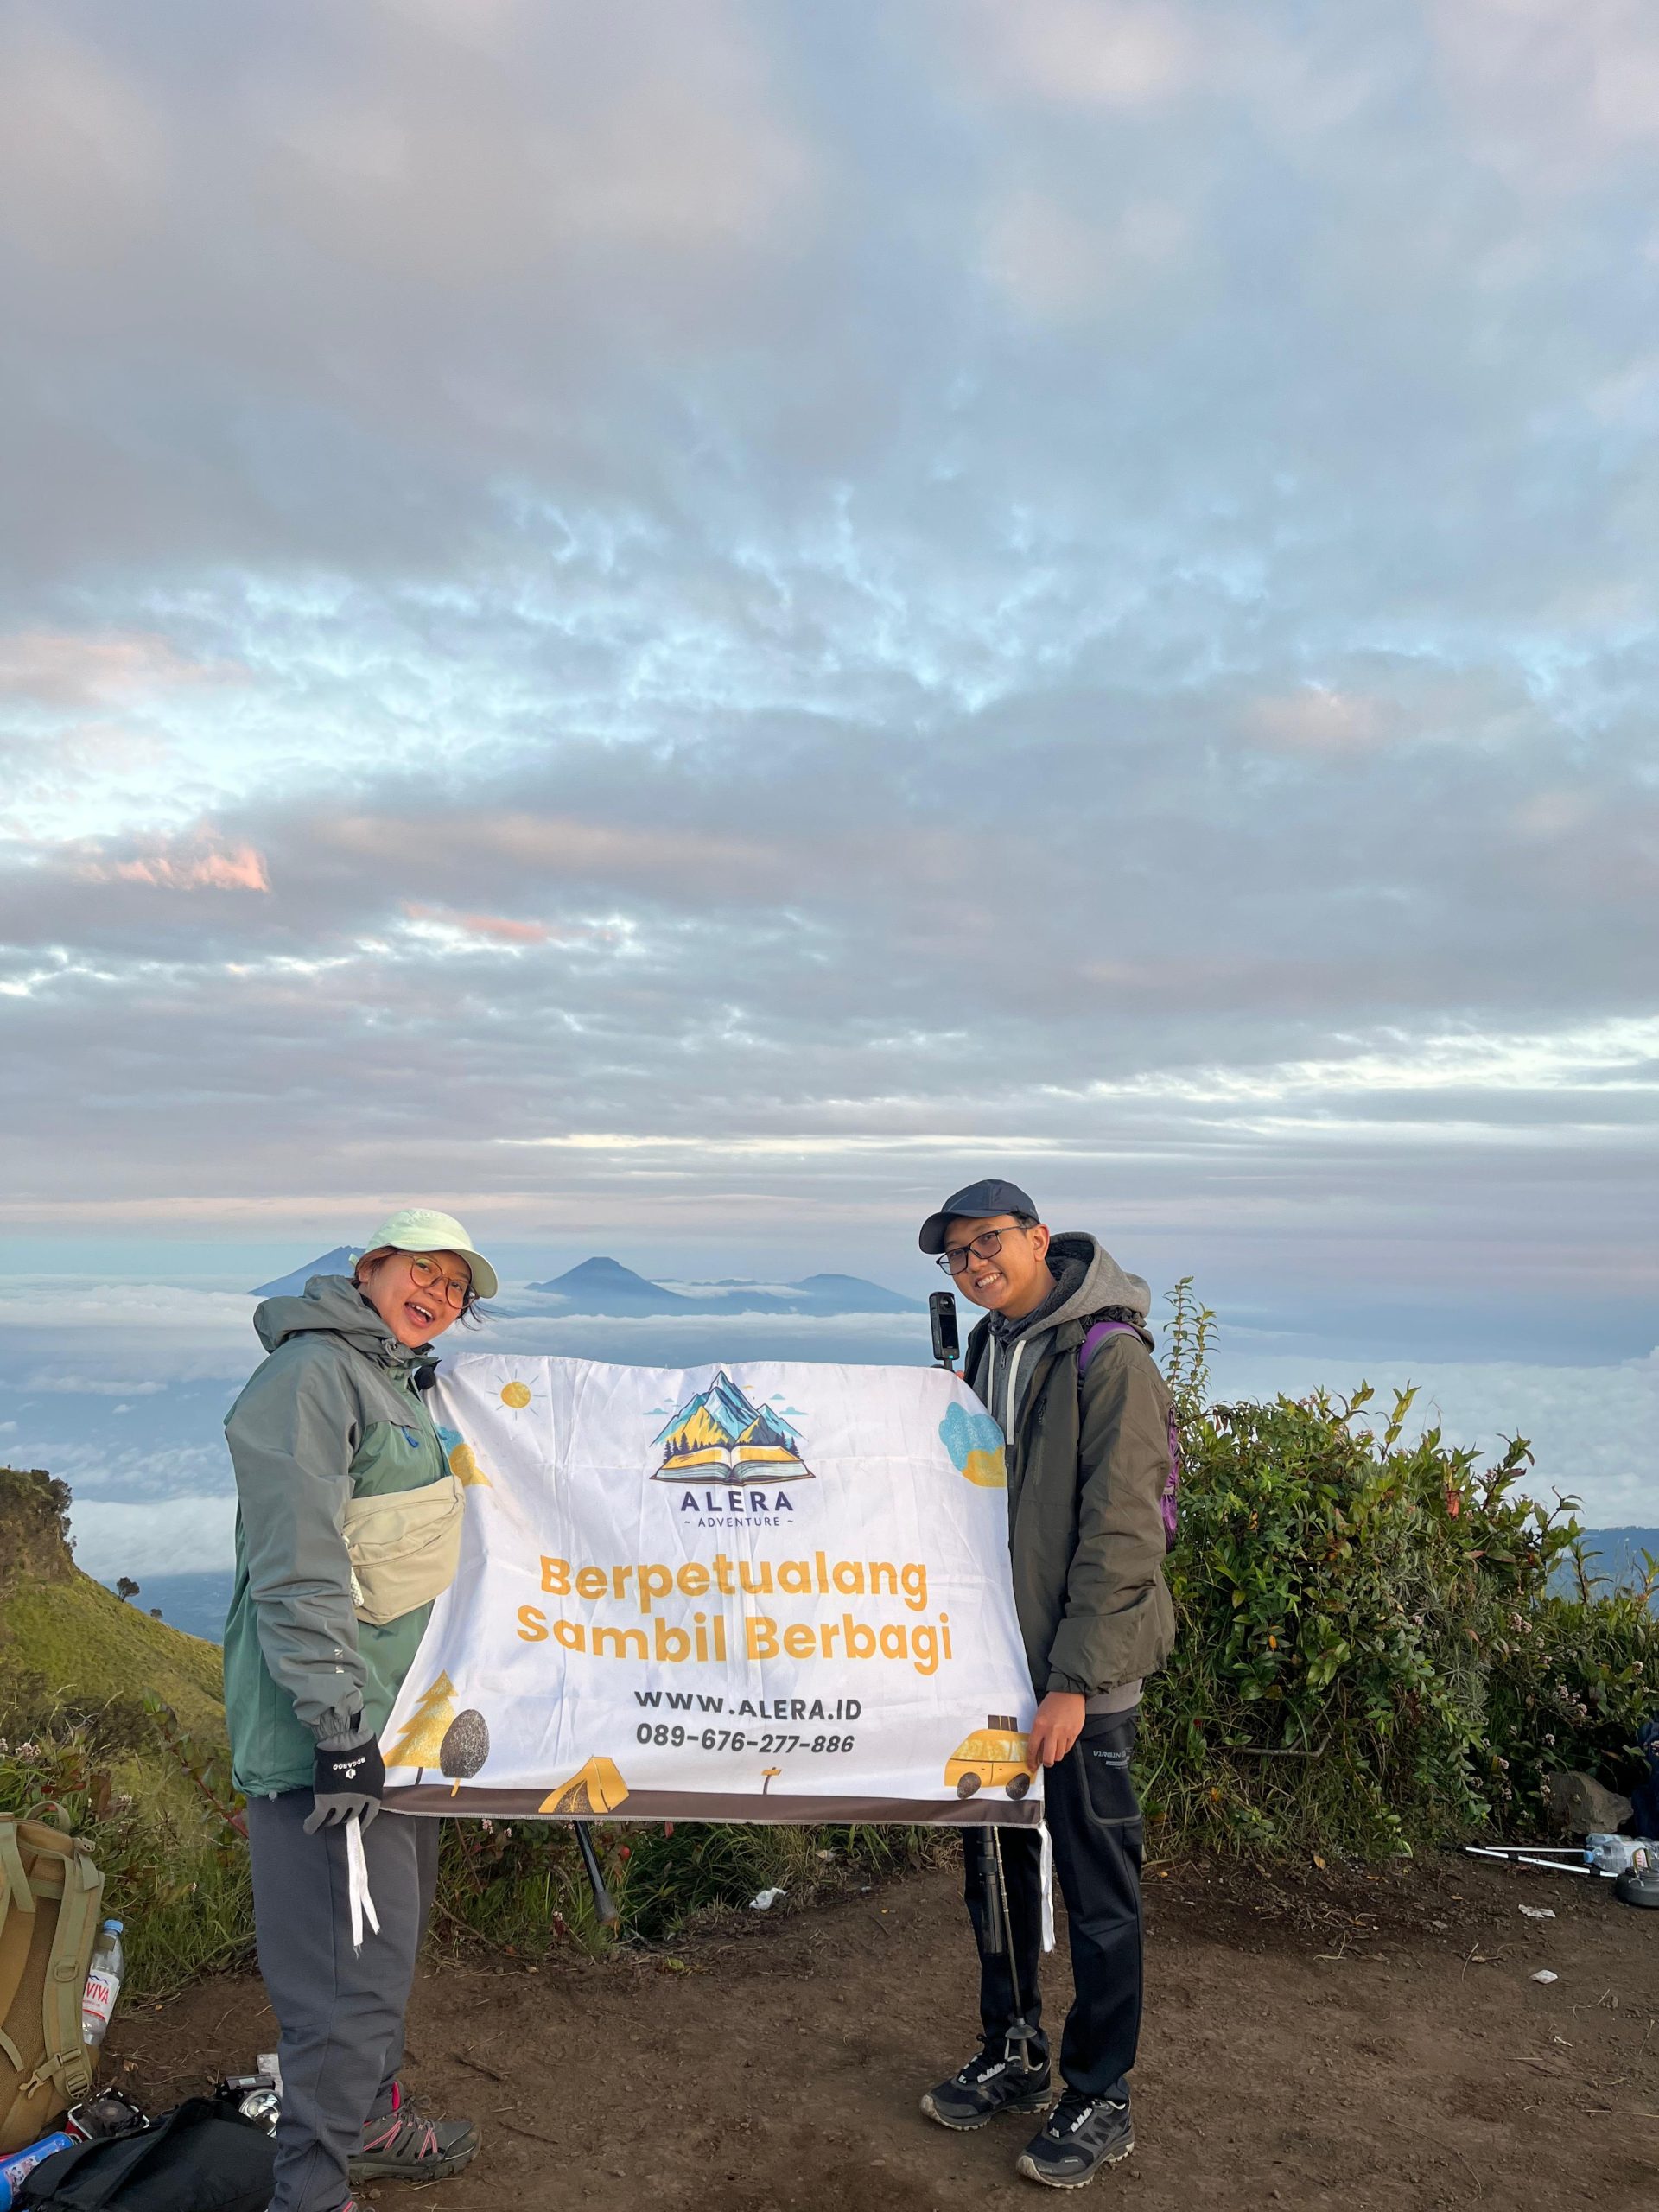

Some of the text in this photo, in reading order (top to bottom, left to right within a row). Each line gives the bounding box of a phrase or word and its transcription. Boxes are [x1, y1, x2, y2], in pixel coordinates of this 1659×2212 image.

[680, 1491, 794, 1512] ALERA
[698, 1516, 780, 1528] ADVENTURE
[540, 1551, 927, 1611] Berpetualang
[517, 1605, 952, 1676] Sambil Berbagi
[634, 1691, 862, 1720] WWW.ALERA.ID
[636, 1723, 855, 1753] 089-676-277-886
[86, 1982, 110, 2005] VIVA
